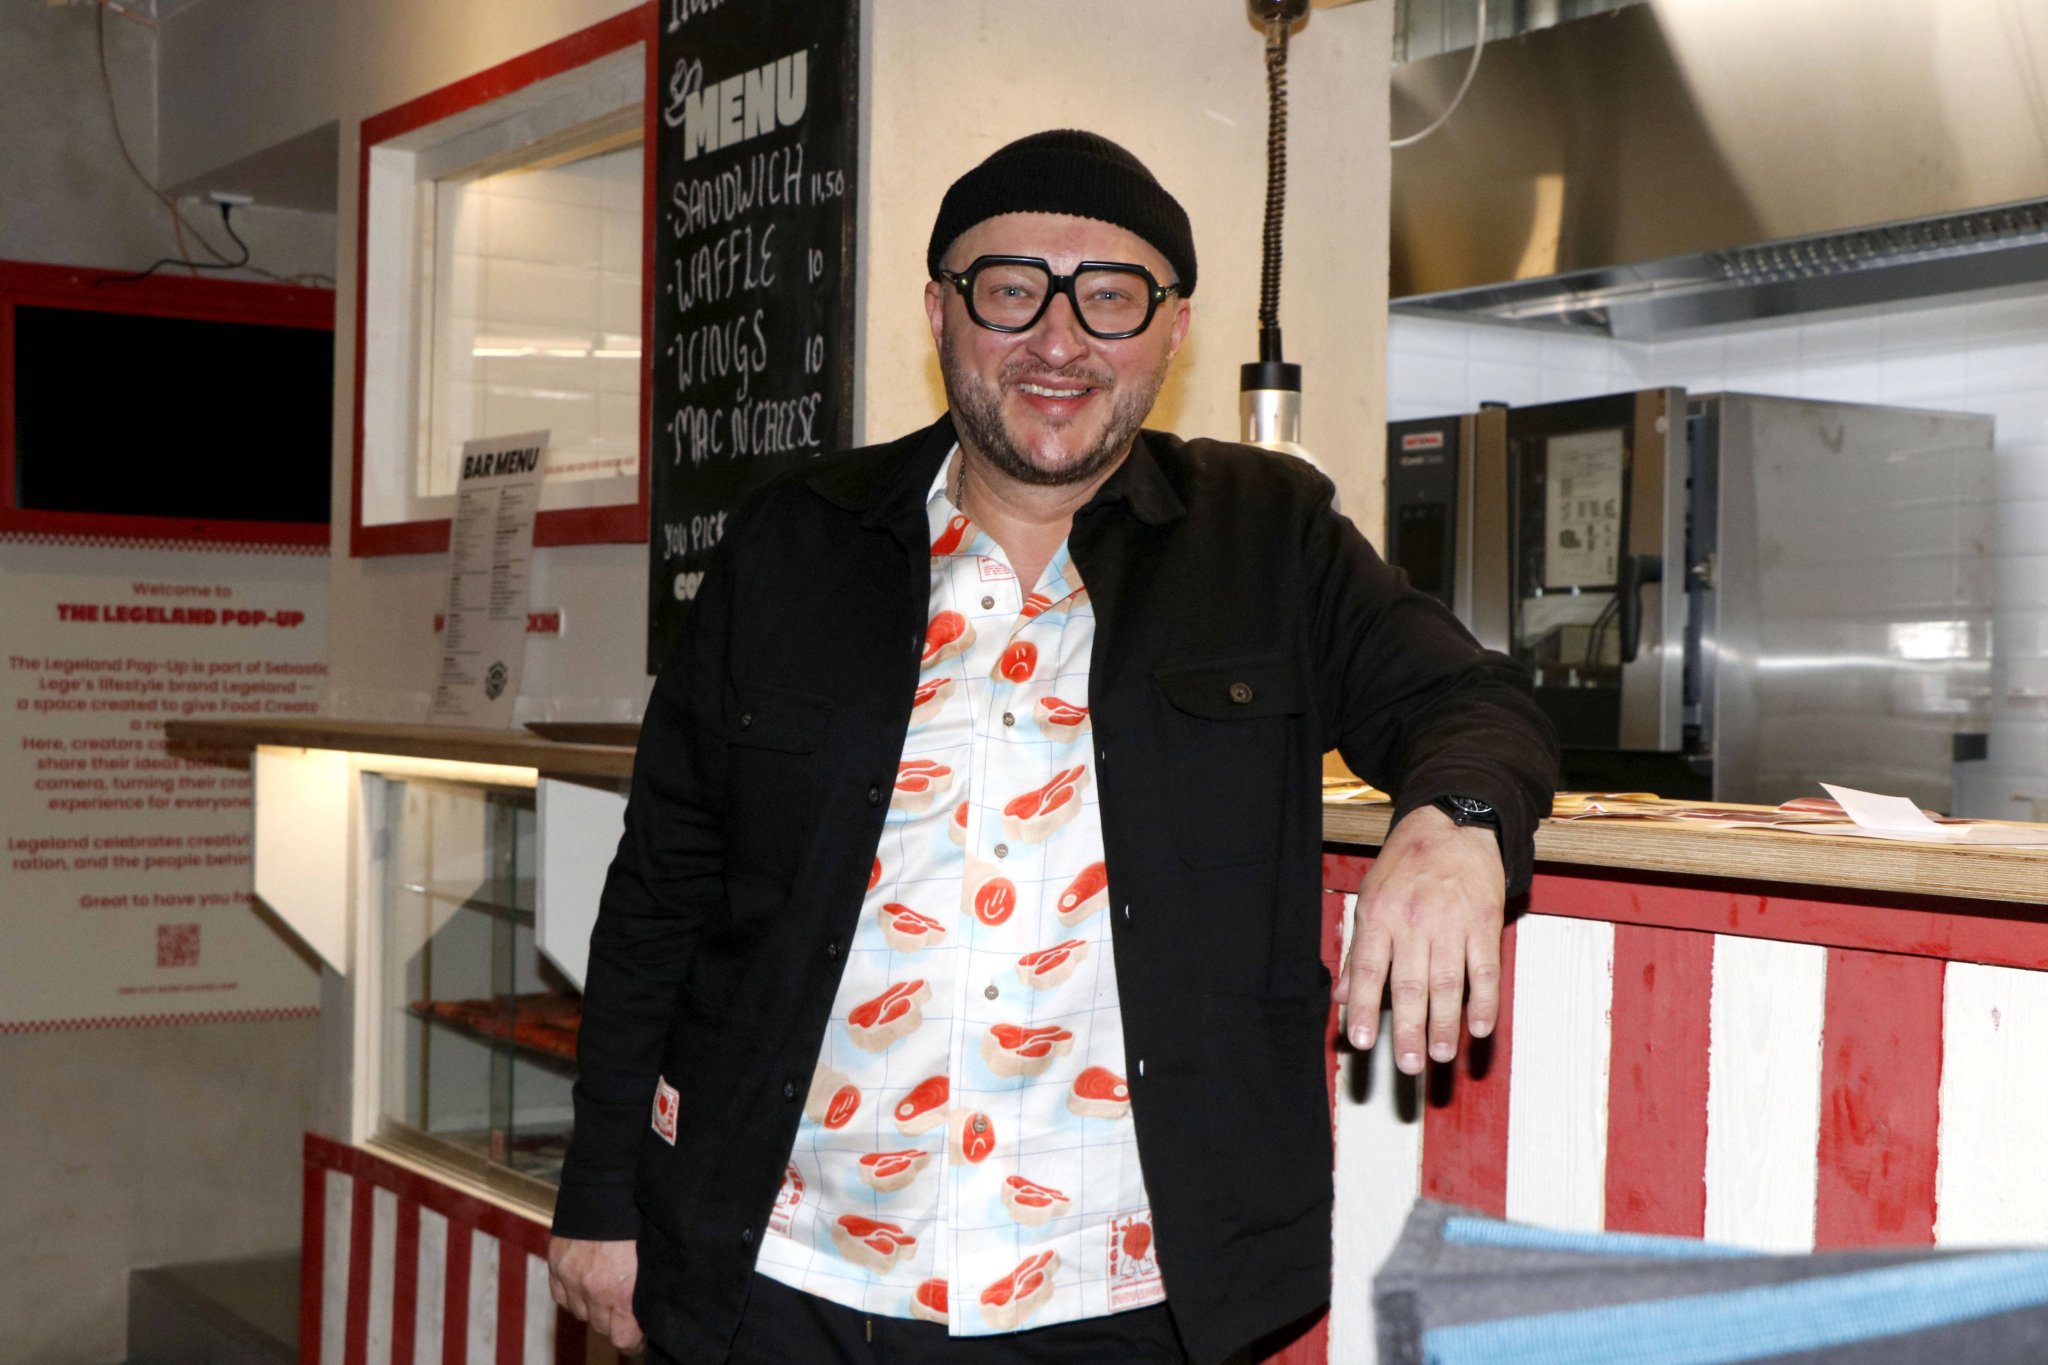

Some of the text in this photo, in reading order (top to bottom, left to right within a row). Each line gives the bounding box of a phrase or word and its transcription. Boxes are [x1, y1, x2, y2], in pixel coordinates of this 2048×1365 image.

[684, 49, 808, 162] MENU
[673, 142, 803, 238] SANDWICH
[675, 223, 824, 311] WAFFLE 10
[805, 333, 824, 374] 10
[675, 405, 723, 465] MAC
[463, 454, 493, 480] BAR
[494, 447, 540, 476] MENU
[133, 581, 233, 597] Welcome to
[57, 603, 304, 628] THE LEGELAND POP-UP
[10, 656, 41, 670] The
[45, 658, 122, 675] Legeland
[126, 658, 188, 676] Pop-Up
[193, 661, 205, 673] is
[209, 661, 242, 676] part
[246, 661, 261, 673] of
[39, 677, 95, 695] Lege's
[99, 677, 164, 695] lifestyle
[168, 679, 219, 692] brand
[223, 681, 297, 697] Legeland
[33, 700, 86, 714] space
[90, 697, 158, 712] created
[161, 700, 179, 712] to
[181, 699, 218, 715] give
[221, 700, 261, 713] Food
[130, 719, 142, 730] a
[70, 738, 144, 750] creators
[37, 756, 87, 770] share
[91, 757, 130, 770] their
[134, 758, 179, 770] ideas
[112, 778, 175, 793] turning
[178, 778, 216, 790] their
[48, 797, 251, 814] experience for everyone
[9, 836, 89, 853] Legeland
[93, 835, 182, 848] celebrates
[74, 855, 109, 870] and
[112, 856, 141, 869] the
[144, 855, 201, 871] people
[79, 895, 128, 909] Great
[133, 896, 150, 908] to
[154, 893, 195, 908] have
[200, 893, 230, 908] you
